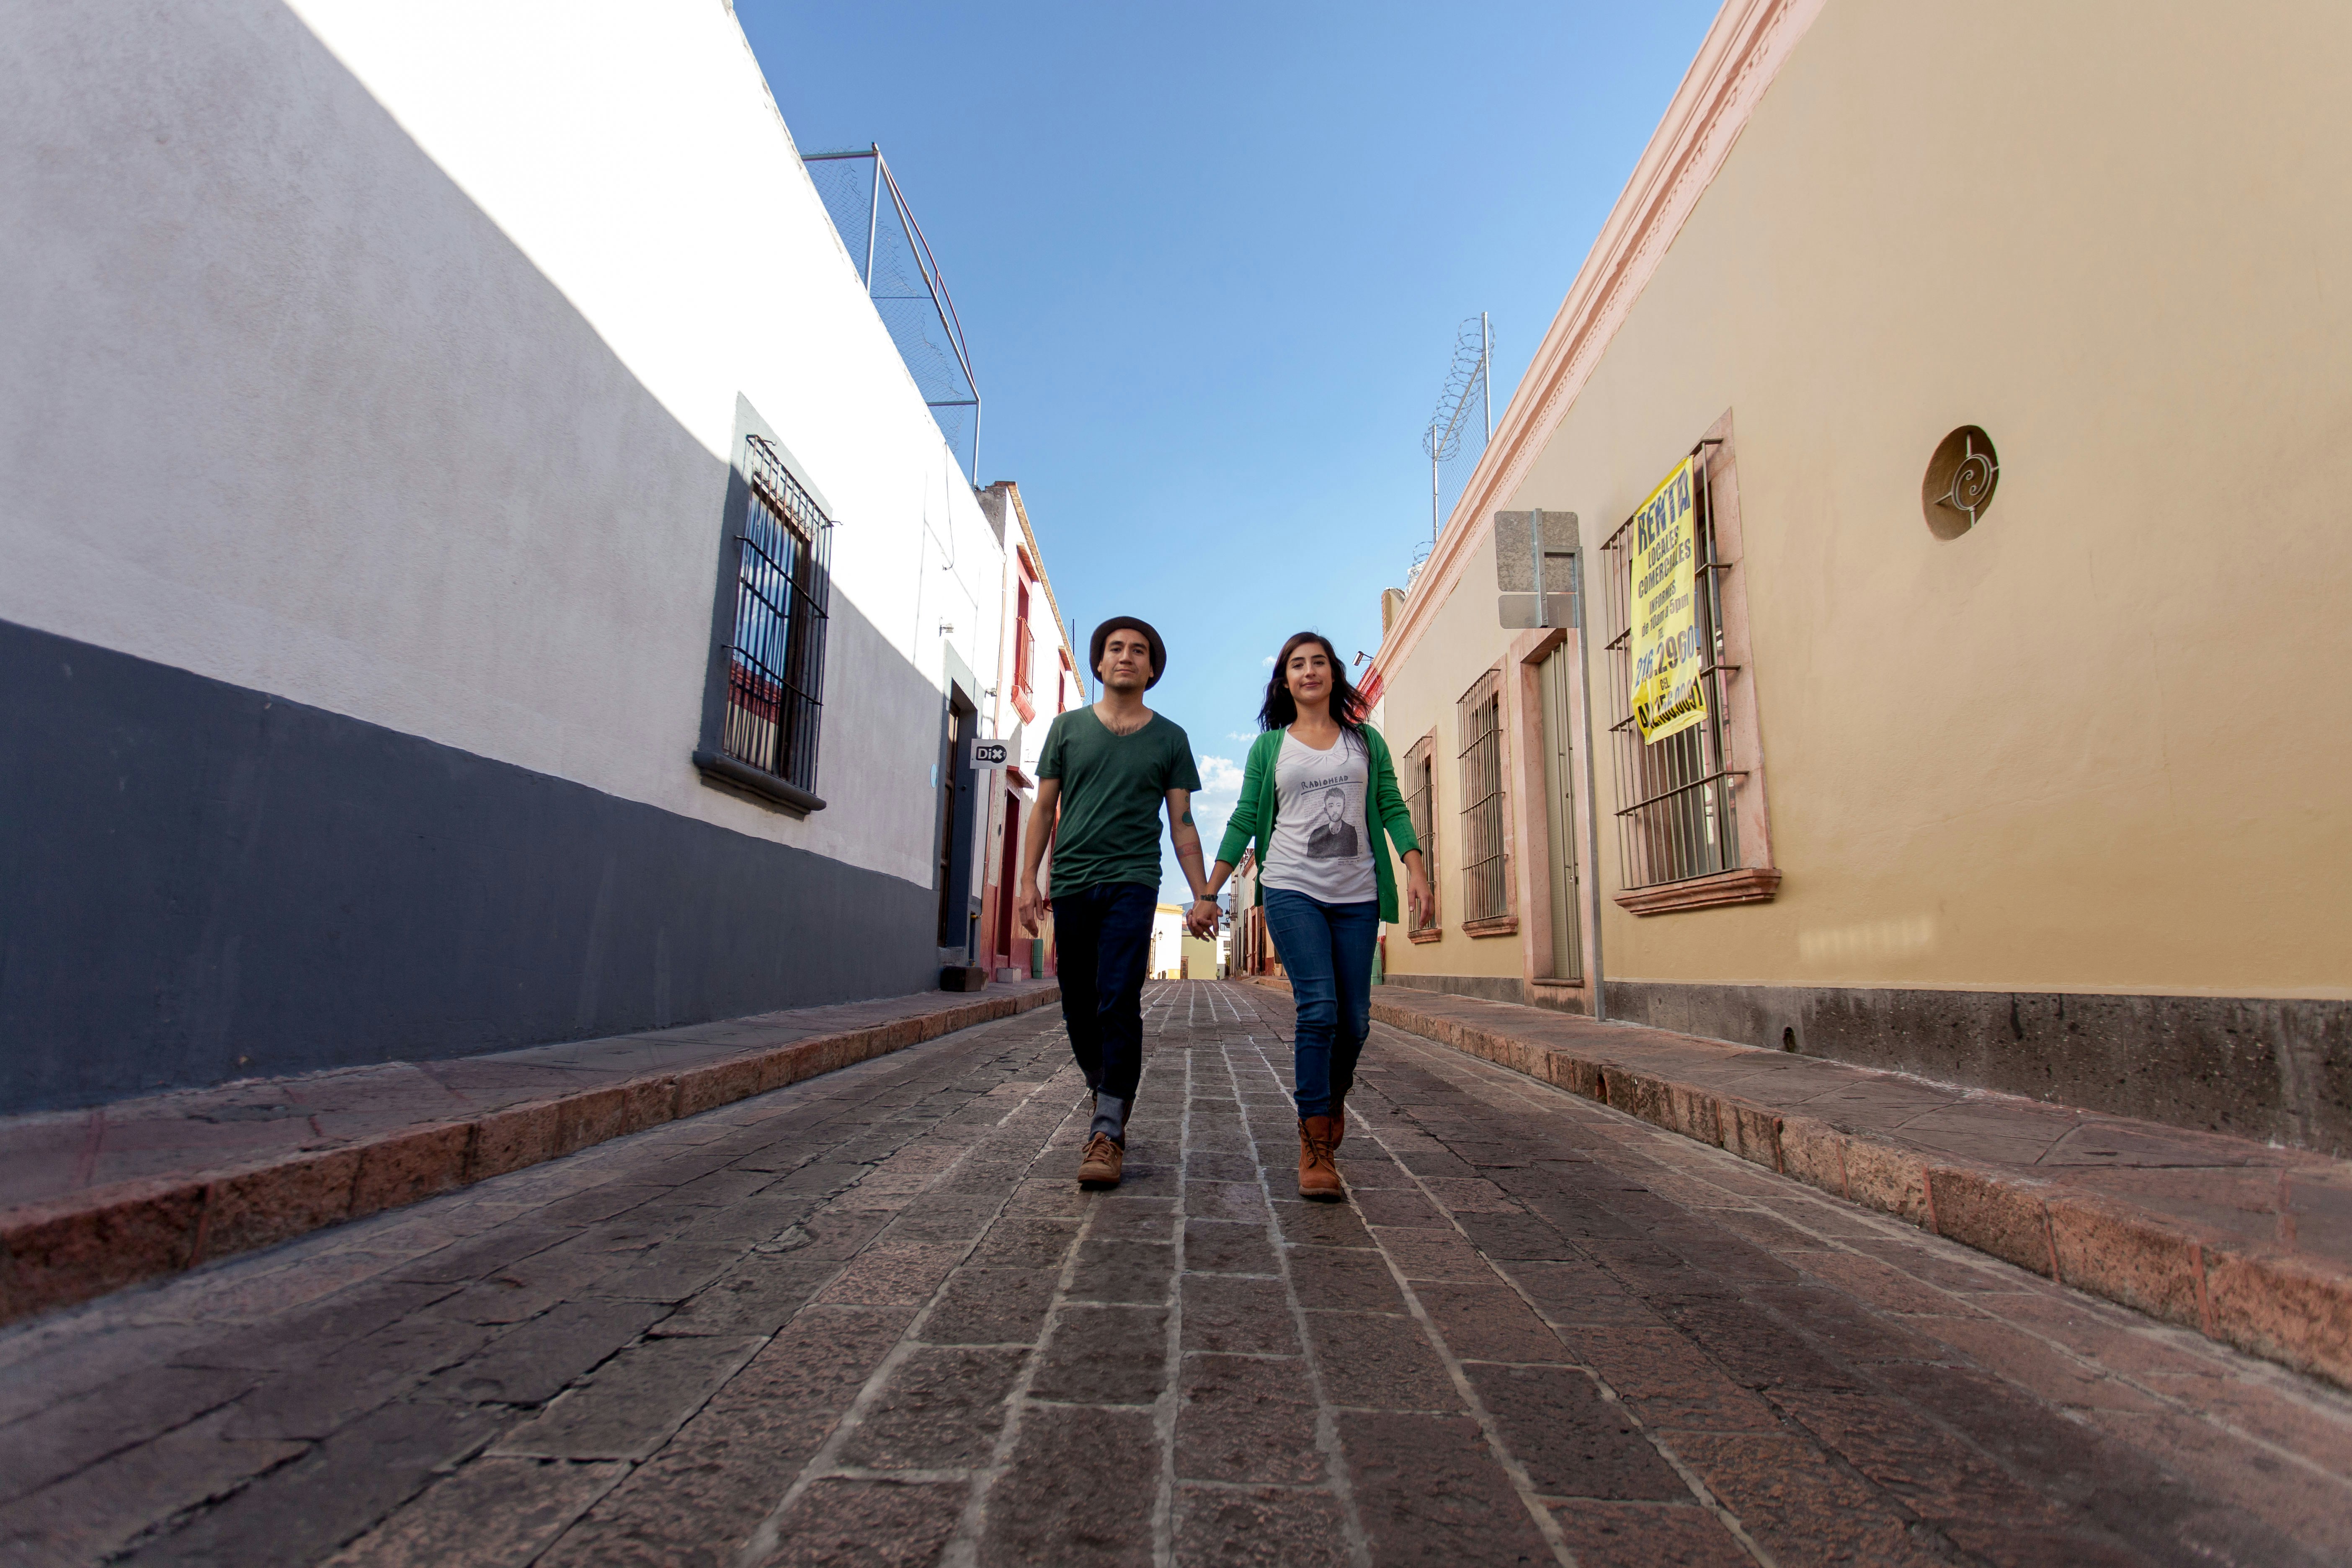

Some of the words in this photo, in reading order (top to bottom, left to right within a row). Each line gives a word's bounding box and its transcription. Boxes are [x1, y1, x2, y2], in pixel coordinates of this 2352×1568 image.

[1638, 469, 1690, 556] RENTA
[1639, 538, 1690, 598] COMERCIALES
[1648, 525, 1679, 570] LOCALES
[1642, 622, 1649, 637] de
[1650, 609, 1664, 631] 10am
[1665, 605, 1669, 618] a
[1669, 593, 1689, 614] 5pm
[1649, 579, 1676, 615] INFORMES
[1635, 625, 1694, 688] 216.2960
[977, 748, 1003, 759] Dix
